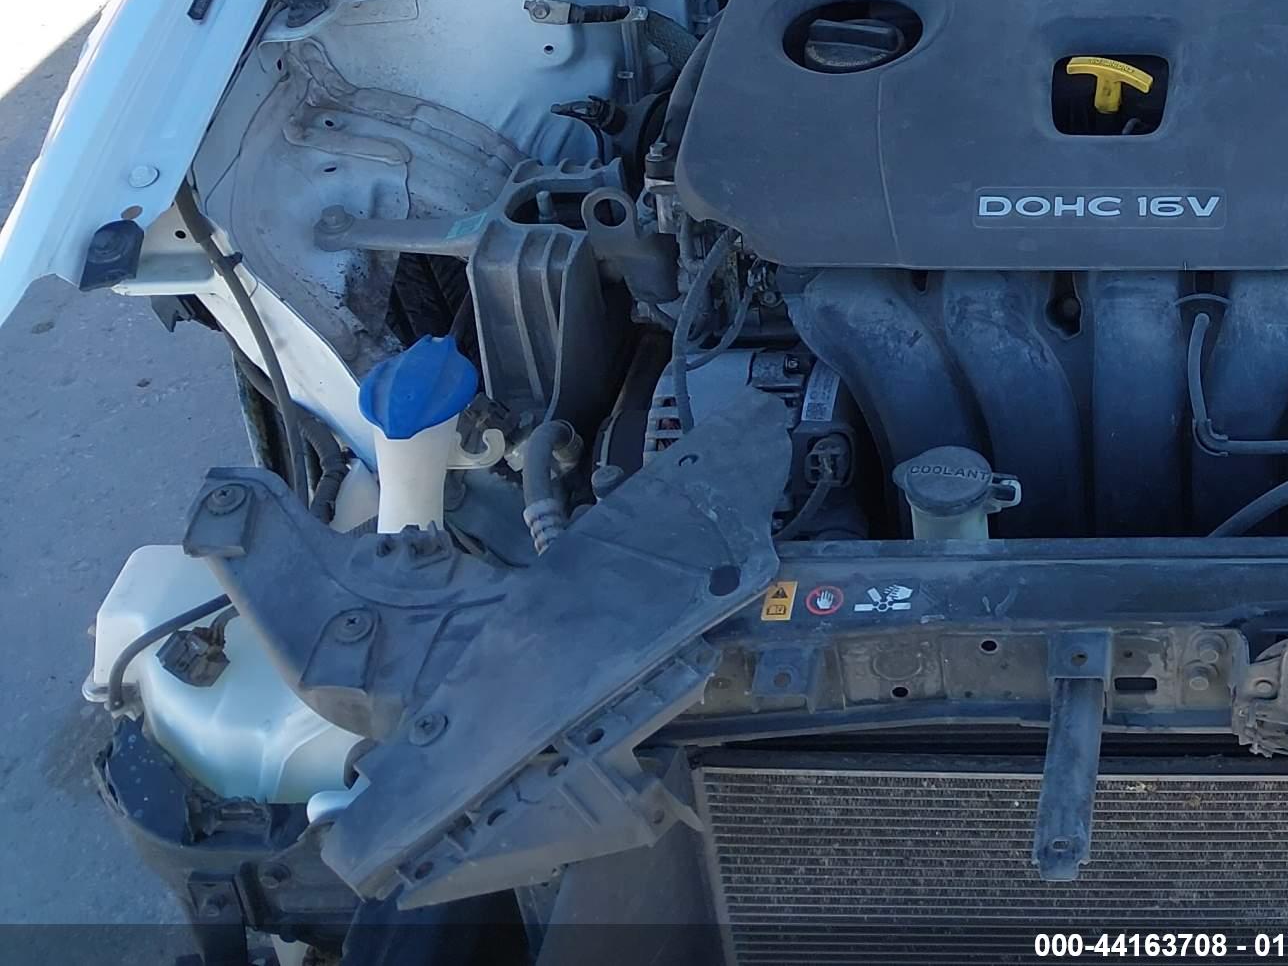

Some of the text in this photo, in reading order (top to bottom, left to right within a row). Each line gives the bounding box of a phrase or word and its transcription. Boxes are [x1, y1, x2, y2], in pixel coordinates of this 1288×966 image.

[978, 196, 1220, 217] DOHC 16V
[910, 465, 988, 481] COOLANT
